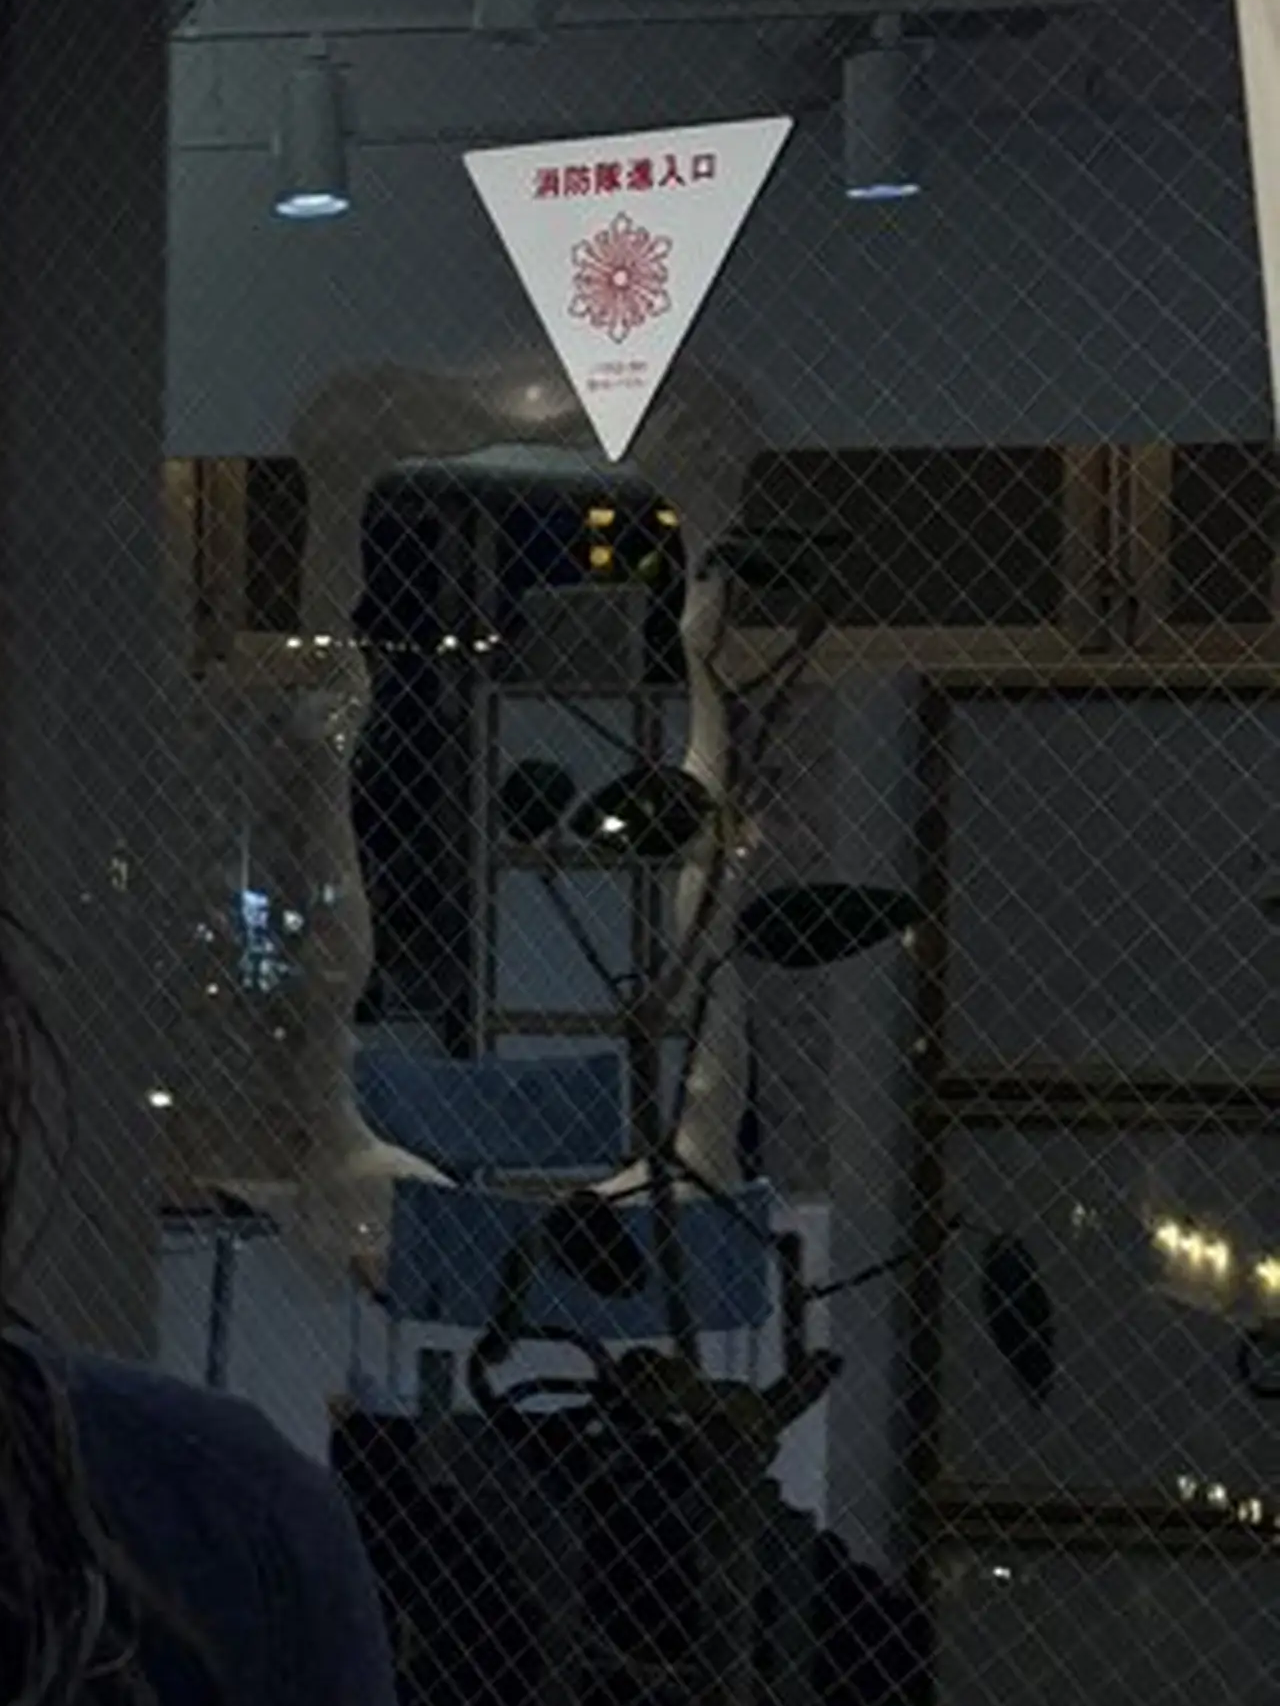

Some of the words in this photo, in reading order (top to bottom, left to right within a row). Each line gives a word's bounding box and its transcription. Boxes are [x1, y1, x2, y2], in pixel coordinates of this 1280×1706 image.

[534, 153, 717, 200] 消防隊進入口
